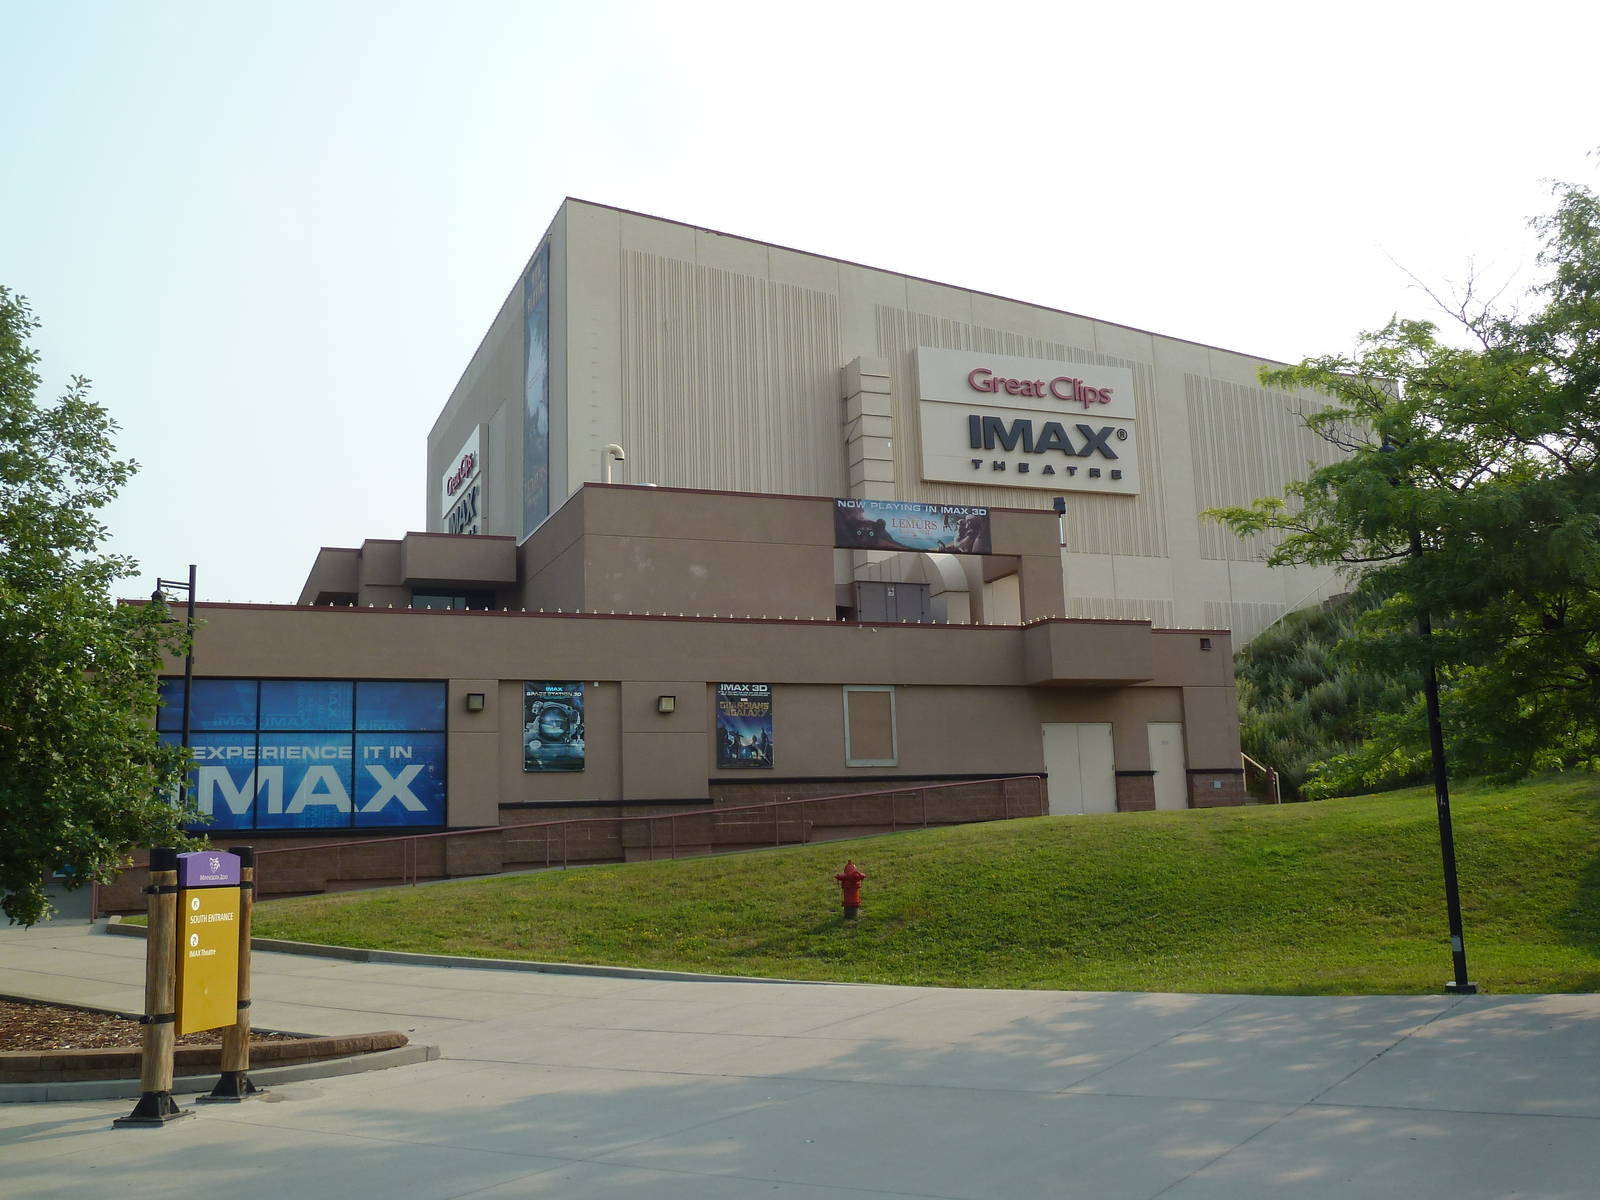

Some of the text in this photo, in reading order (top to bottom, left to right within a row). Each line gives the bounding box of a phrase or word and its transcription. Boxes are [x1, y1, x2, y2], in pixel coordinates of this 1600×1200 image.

[968, 367, 1113, 409] Great Clips
[971, 458, 1123, 480] THEATRE
[837, 500, 987, 516] NOW PLAYING IN IMAX 3D
[891, 518, 938, 530] LEMURS
[720, 683, 749, 691] IMAX
[192, 745, 413, 760] EXPERIENCE IT IN
[190, 912, 234, 924] SOUTH ENTRANCE
[188, 949, 201, 958] IMAX
